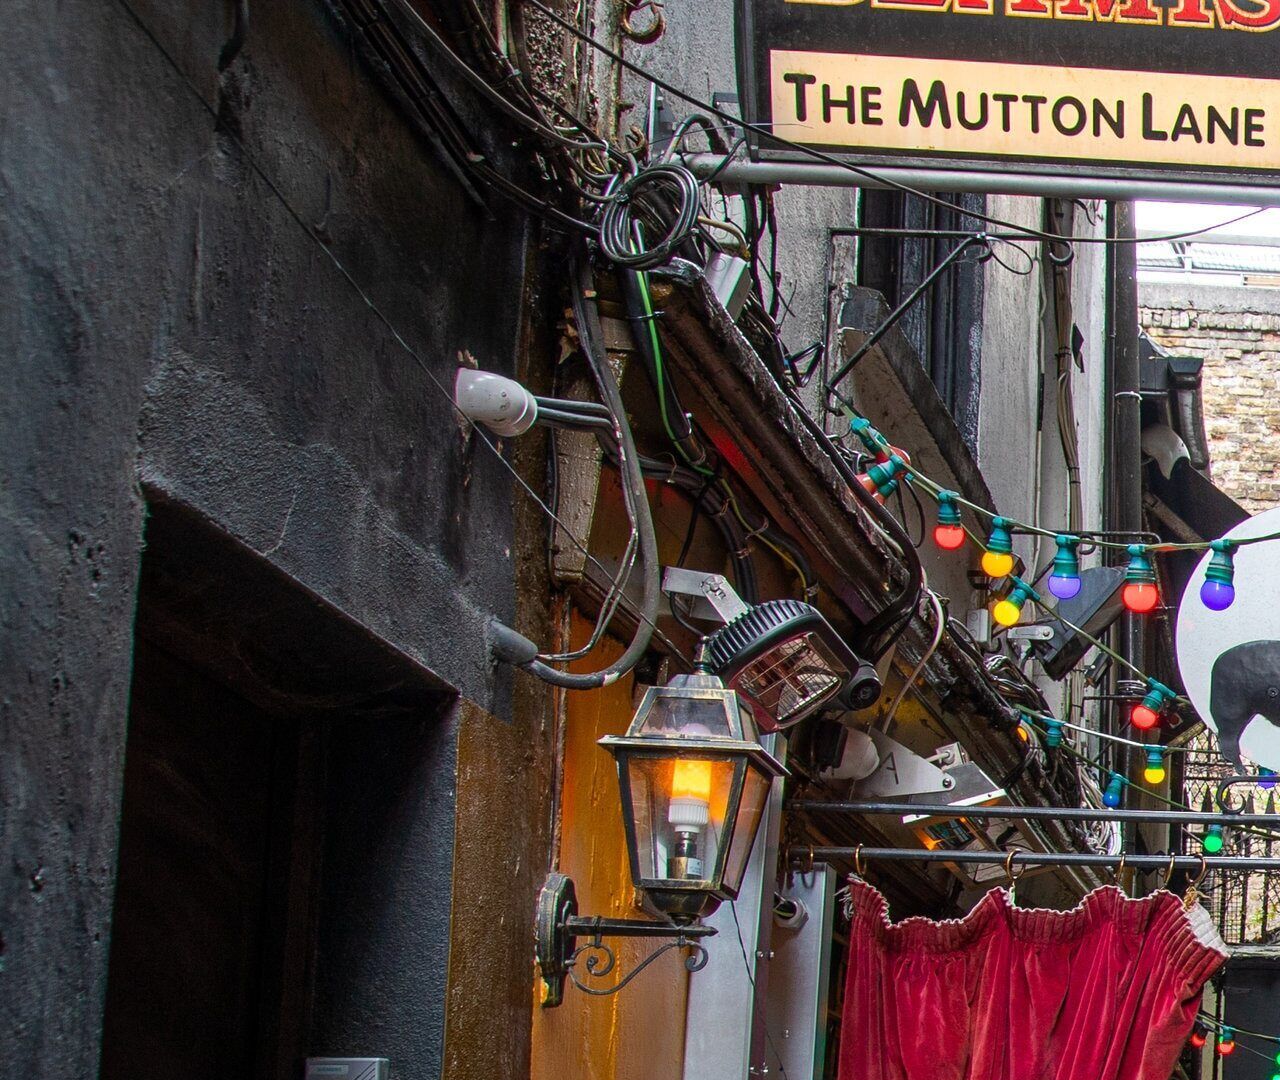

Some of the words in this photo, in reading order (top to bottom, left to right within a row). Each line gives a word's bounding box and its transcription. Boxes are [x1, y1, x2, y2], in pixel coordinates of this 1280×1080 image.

[784, 72, 883, 126] THE
[899, 78, 1126, 138] MUTTON
[1142, 92, 1265, 148] LANE
